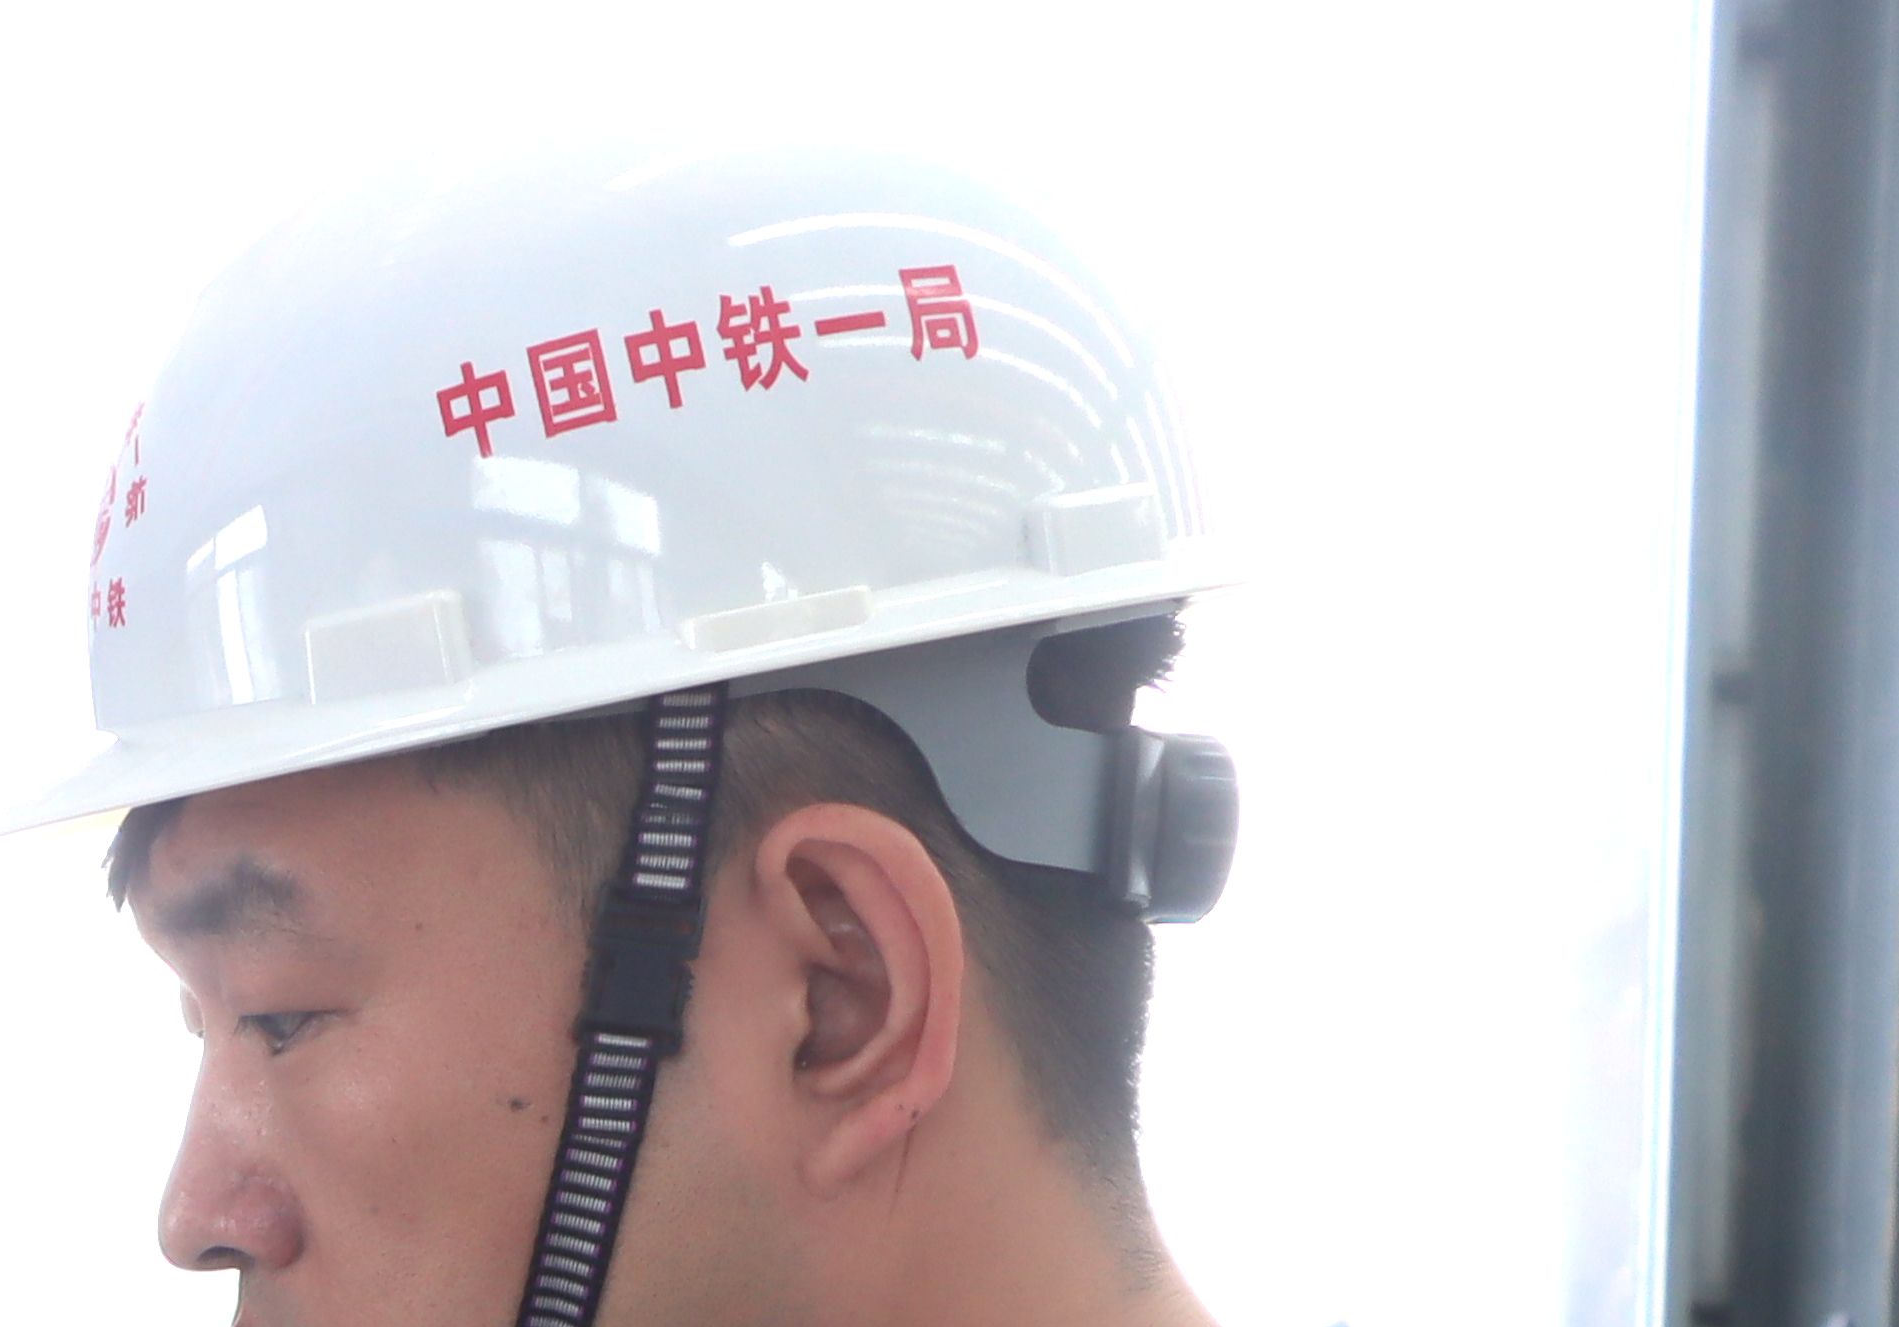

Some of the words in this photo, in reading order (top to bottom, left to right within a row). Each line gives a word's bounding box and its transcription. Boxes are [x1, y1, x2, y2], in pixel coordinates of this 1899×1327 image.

[436, 264, 980, 459] 中国中铁一局
